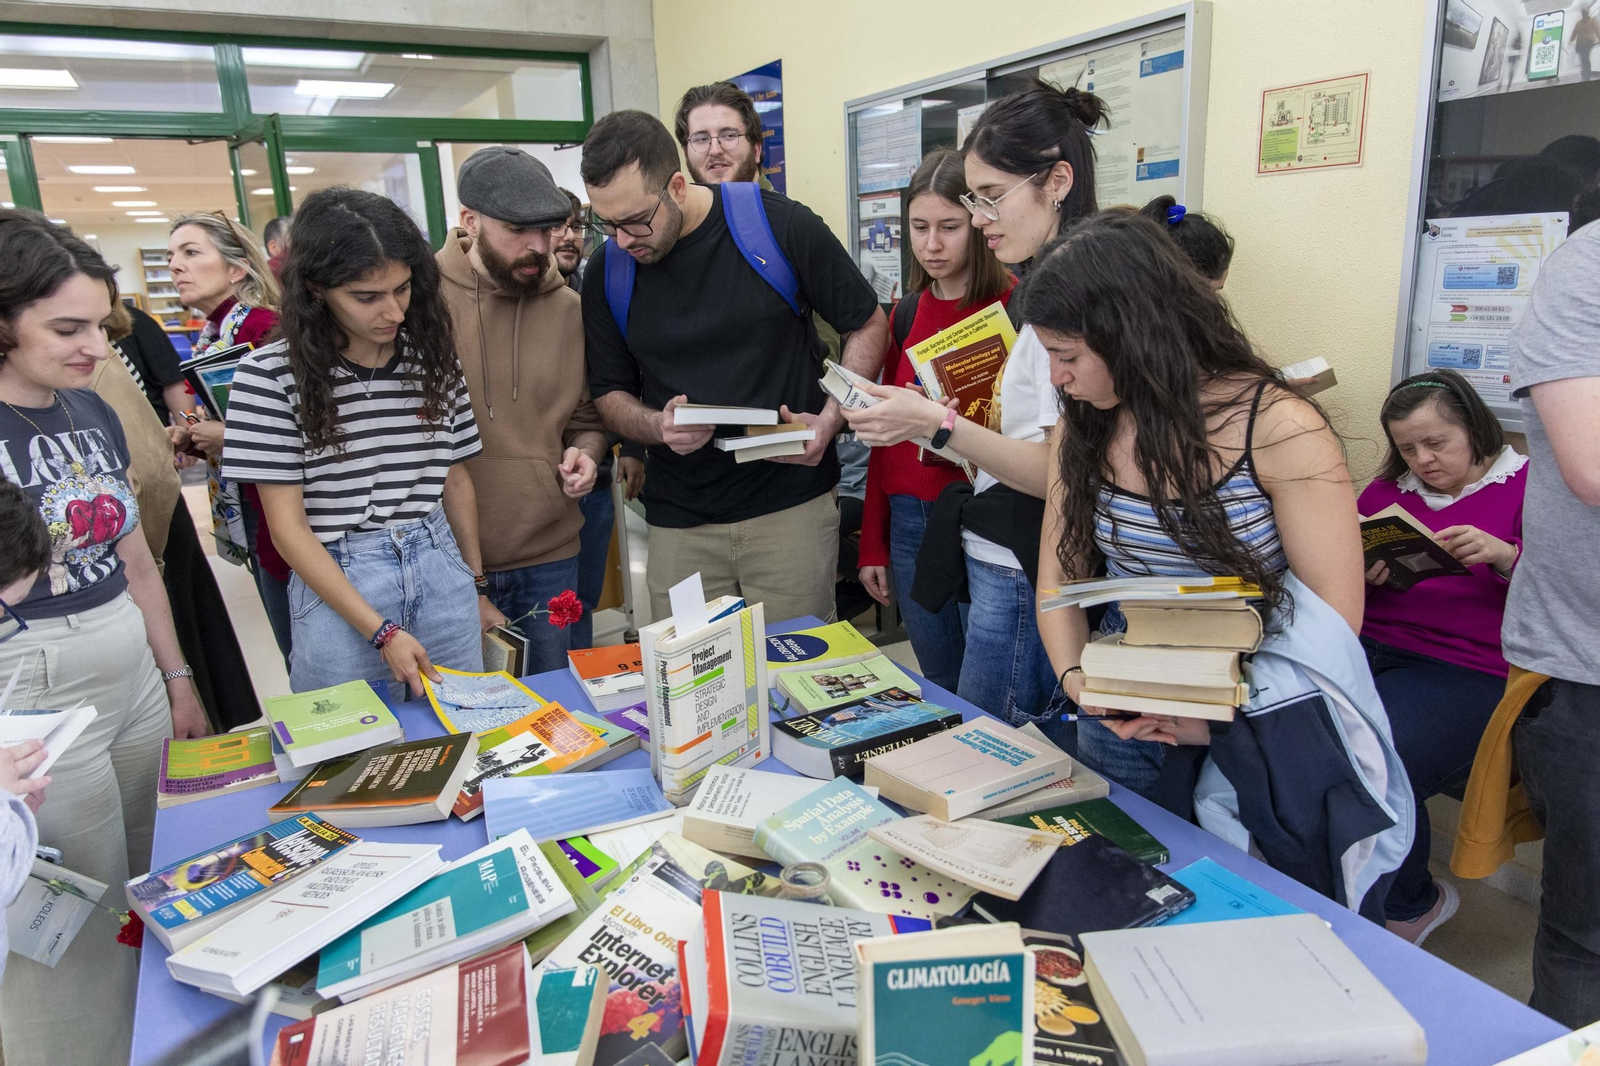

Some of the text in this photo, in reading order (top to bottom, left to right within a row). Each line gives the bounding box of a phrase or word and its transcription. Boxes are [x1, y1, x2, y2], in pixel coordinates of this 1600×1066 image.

[944, 345, 1000, 371] Molecular biology and
[951, 353, 998, 375] crop improvement
[847, 391, 860, 408] Love
[0, 428, 124, 489] LOVE
[691, 645, 715, 664] Project
[692, 649, 732, 677] Management
[660, 660, 672, 727] Project Management
[694, 678, 726, 702] STRATEGIC
[695, 695, 717, 713] DESIGN
[535, 716, 574, 744] PROYECTOS
[550, 707, 592, 739] SEGUIMIENTO
[697, 709, 710, 724] AND
[697, 702, 745, 735] IMPLEMENTATION
[527, 721, 573, 754] AGRICULTURA
[785, 719, 854, 746] INTERNET
[855, 737, 915, 763] INTERNET
[165, 772, 224, 787] elemental
[696, 775, 720, 811] Historia económica
[709, 783, 724, 806] pensamiento
[722, 773, 730, 784] social
[782, 789, 855, 832] Spatial Data
[809, 804, 875, 846] by Example
[816, 796, 865, 827] Analysis
[299, 816, 338, 840] LA BIBLIA DE
[839, 827, 861, 842] VOLUME
[269, 829, 330, 866] Netscape
[519, 844, 529, 857] EL
[885, 830, 1014, 887] FEED COMPOSITION
[477, 858, 497, 881] MAP
[528, 857, 554, 893] PROBLEMA
[29, 900, 54, 931] KOLEOS
[600, 914, 637, 940] Microsoft
[609, 905, 622, 916] El
[623, 911, 653, 935] Libro
[590, 925, 677, 984] Internet
[732, 913, 765, 988] COLLINS
[760, 917, 796, 993] COBUILD
[793, 921, 833, 997] ENGLISH
[819, 917, 857, 1008] LANGUAGE
[887, 959, 1011, 990] CLIMATOLOGÍA
[413, 988, 433, 1046] COSTES,
[626, 1012, 660, 1041] 4
[344, 1028, 353, 1046] BASES
[777, 1027, 858, 1058] ENGLIS
